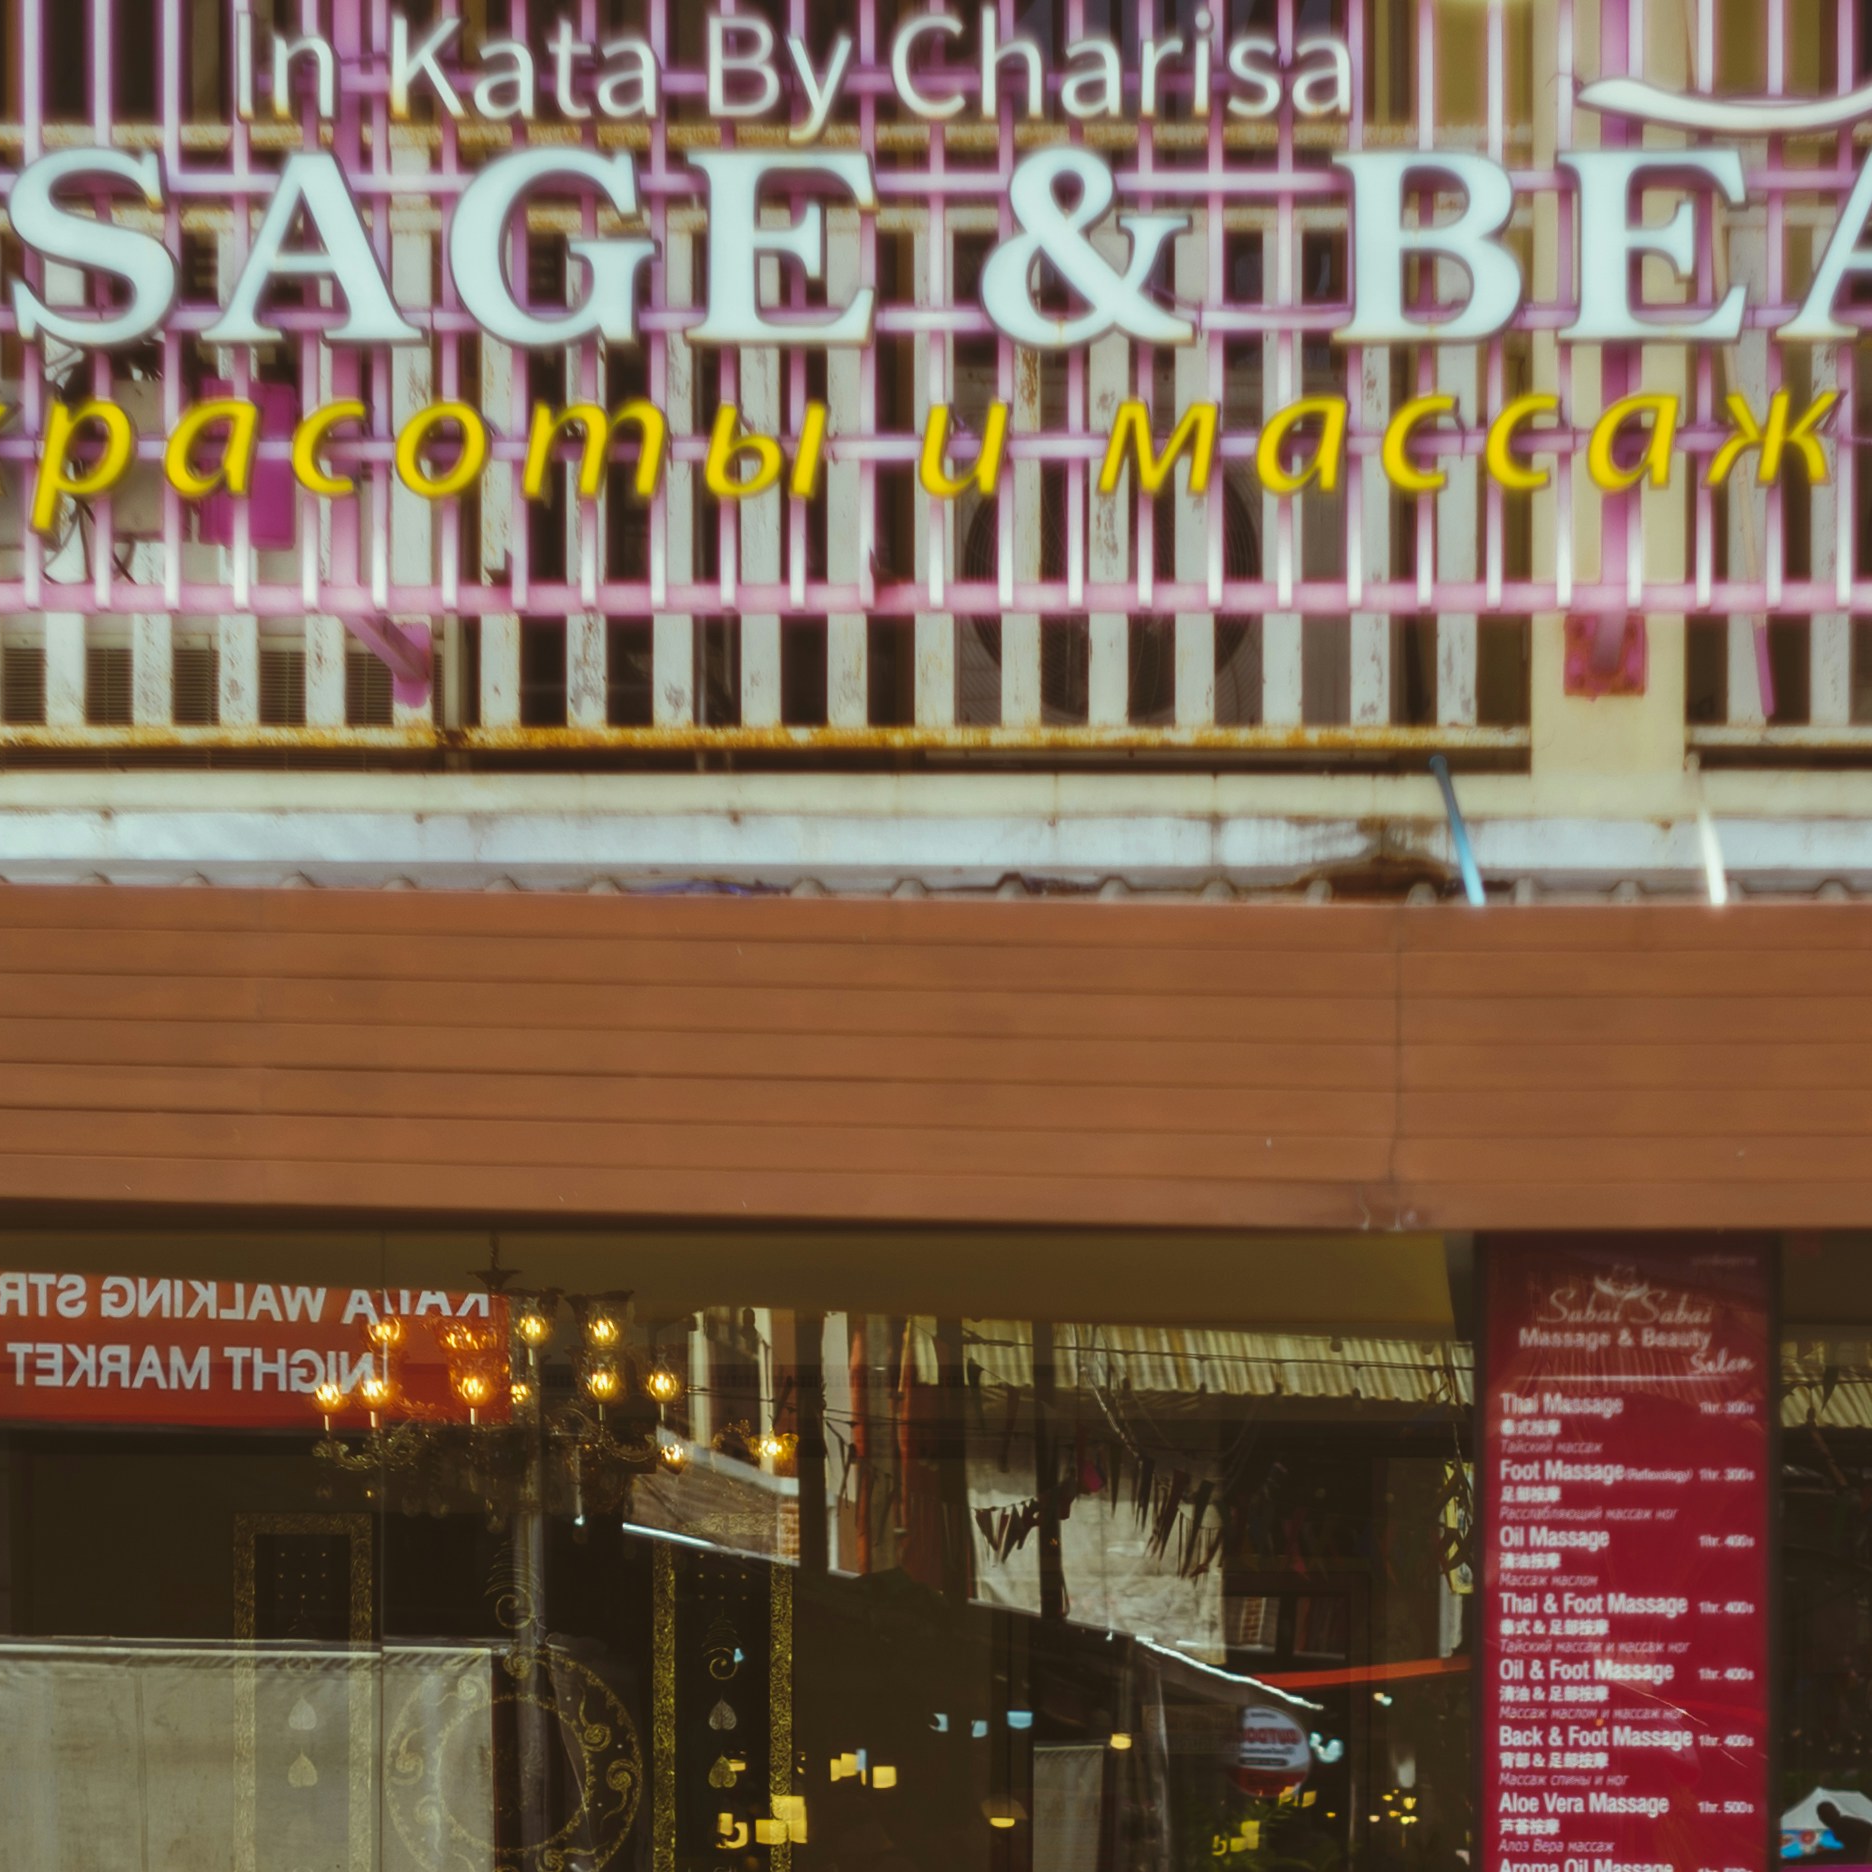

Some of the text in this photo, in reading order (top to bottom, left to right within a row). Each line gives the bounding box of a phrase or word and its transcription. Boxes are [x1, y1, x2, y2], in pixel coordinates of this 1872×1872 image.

[236, 10, 1354, 142] In Kata By Charisa
[978, 146, 1200, 347] &
[917, 400, 1012, 498] и
[1096, 385, 1840, 495] массаж
[1519, 1328, 1610, 1351] Massage
[1642, 1328, 1711, 1350] Beauty
[1500, 1393, 1624, 1418] Thai Massage
[1500, 1460, 1625, 1485] Foot Massage
[1500, 1526, 1610, 1551] Oil Massage
[1500, 1593, 1688, 1619] Thai & Foot Massage
[1499, 1659, 1674, 1685] Oil & Foot Massage
[1499, 1726, 1693, 1752] Back & Foot Massage
[1499, 1792, 1669, 1818] Aloe Vera Massage
